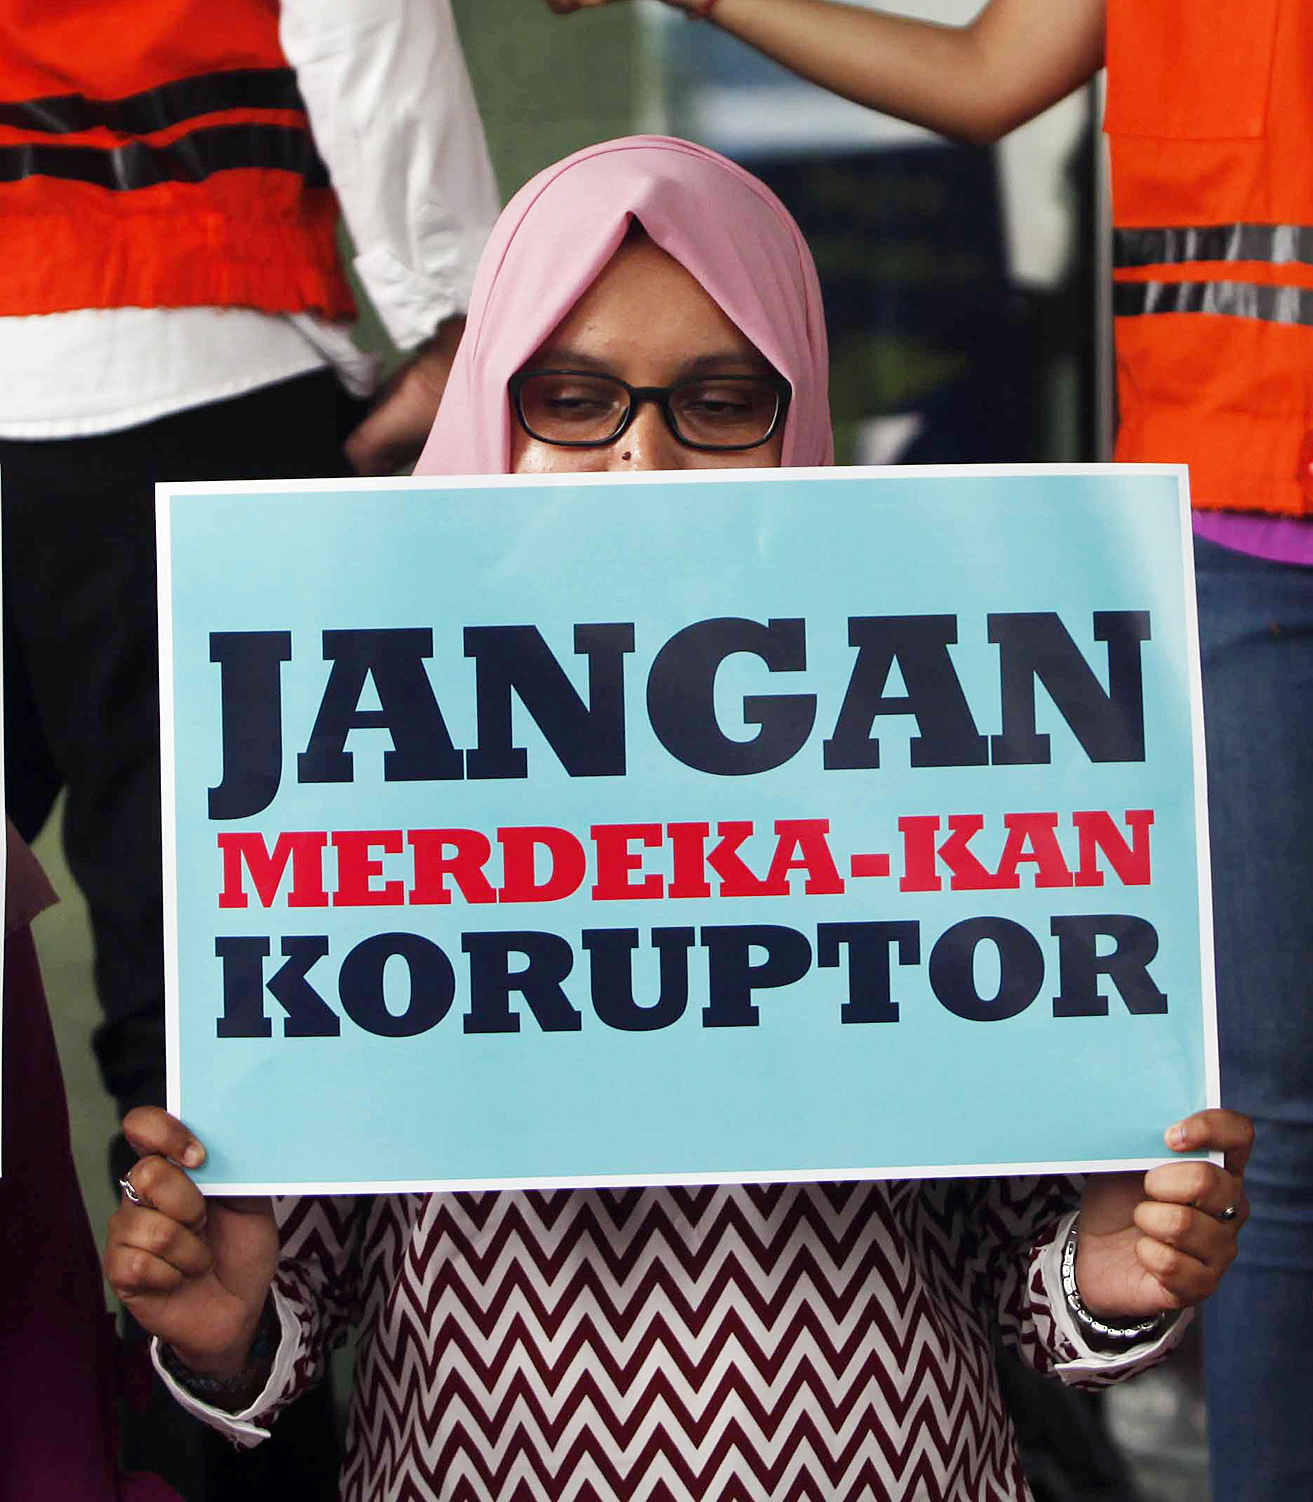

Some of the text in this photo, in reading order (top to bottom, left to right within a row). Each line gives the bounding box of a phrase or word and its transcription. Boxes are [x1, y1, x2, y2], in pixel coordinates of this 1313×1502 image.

[207, 610, 1151, 821] JANGAN
[217, 809, 1155, 909] MERDEKA-KAN
[214, 914, 1169, 1039] KORUPTOR
